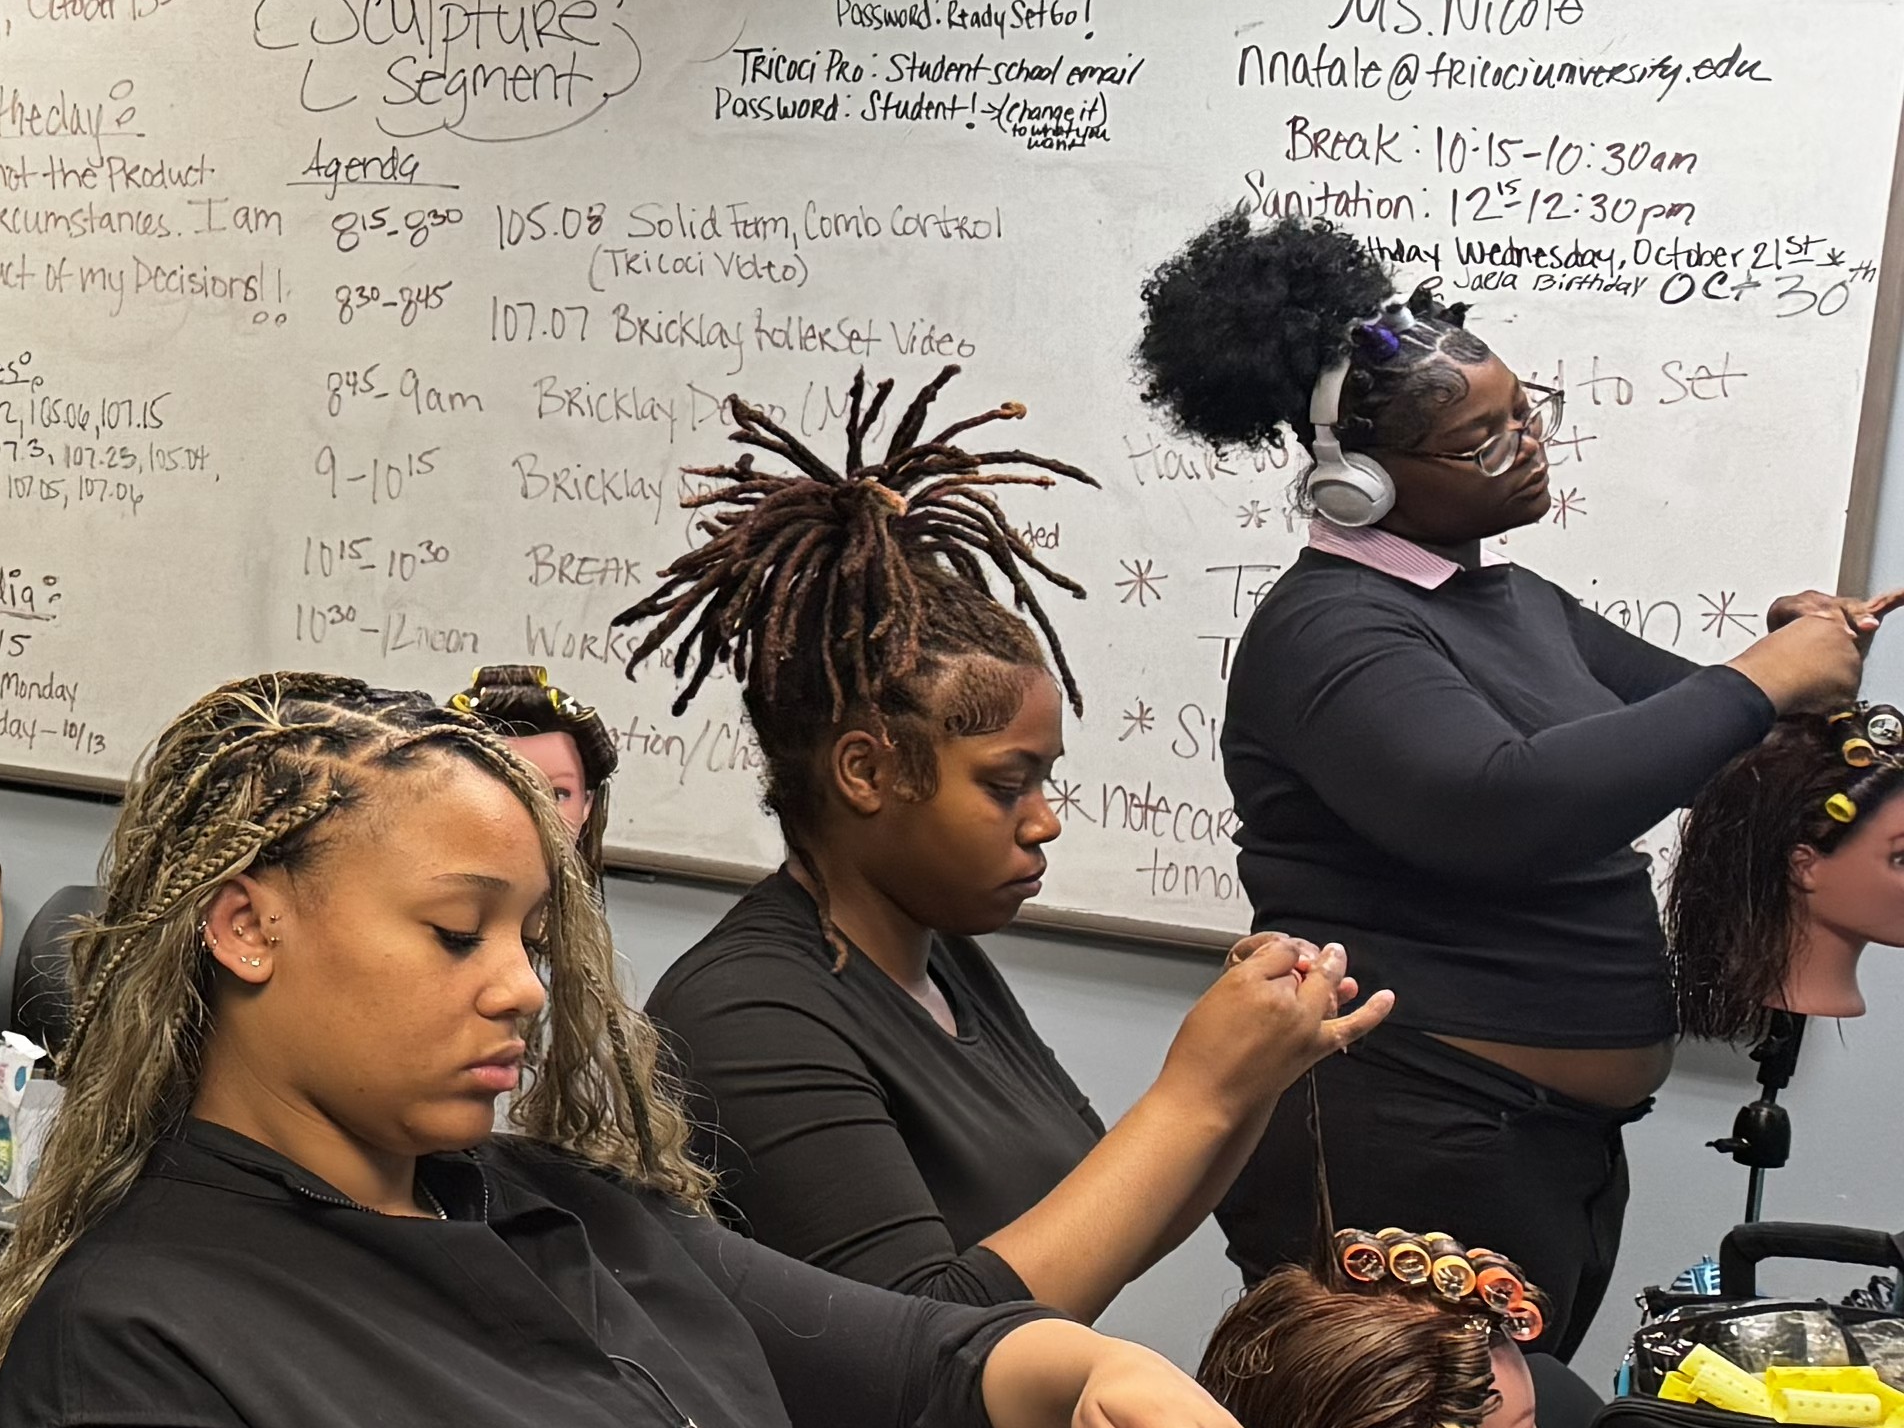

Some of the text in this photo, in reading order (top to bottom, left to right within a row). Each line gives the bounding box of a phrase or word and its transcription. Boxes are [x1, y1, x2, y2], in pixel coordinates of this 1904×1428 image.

[383, 51, 593, 129] Segment
[890, 51, 993, 85] Student
[992, 54, 1065, 86] school
[1065, 52, 1145, 86] email
[714, 85, 852, 122] Password:
[860, 89, 980, 132] Student!
[1285, 114, 1422, 166] Break:
[42, 153, 99, 191] the
[301, 137, 420, 201] Agenda
[186, 196, 230, 236] I
[233, 204, 283, 237] am
[626, 202, 722, 241] Solid
[804, 199, 882, 241] Comb
[1237, 168, 1432, 224] Sanitation:
[1454, 234, 1627, 277] Wednesday,
[1632, 233, 1741, 273] October
[45, 256, 74, 294] of
[80, 265, 126, 319] my
[1531, 272, 1650, 300] Birthday
[491, 294, 590, 342] 107.07
[610, 302, 746, 376] Bricklay
[890, 316, 977, 359] Video
[533, 375, 678, 445] Bricklay
[511, 452, 664, 526] Bricklay
[0, 671, 79, 712] Monday
